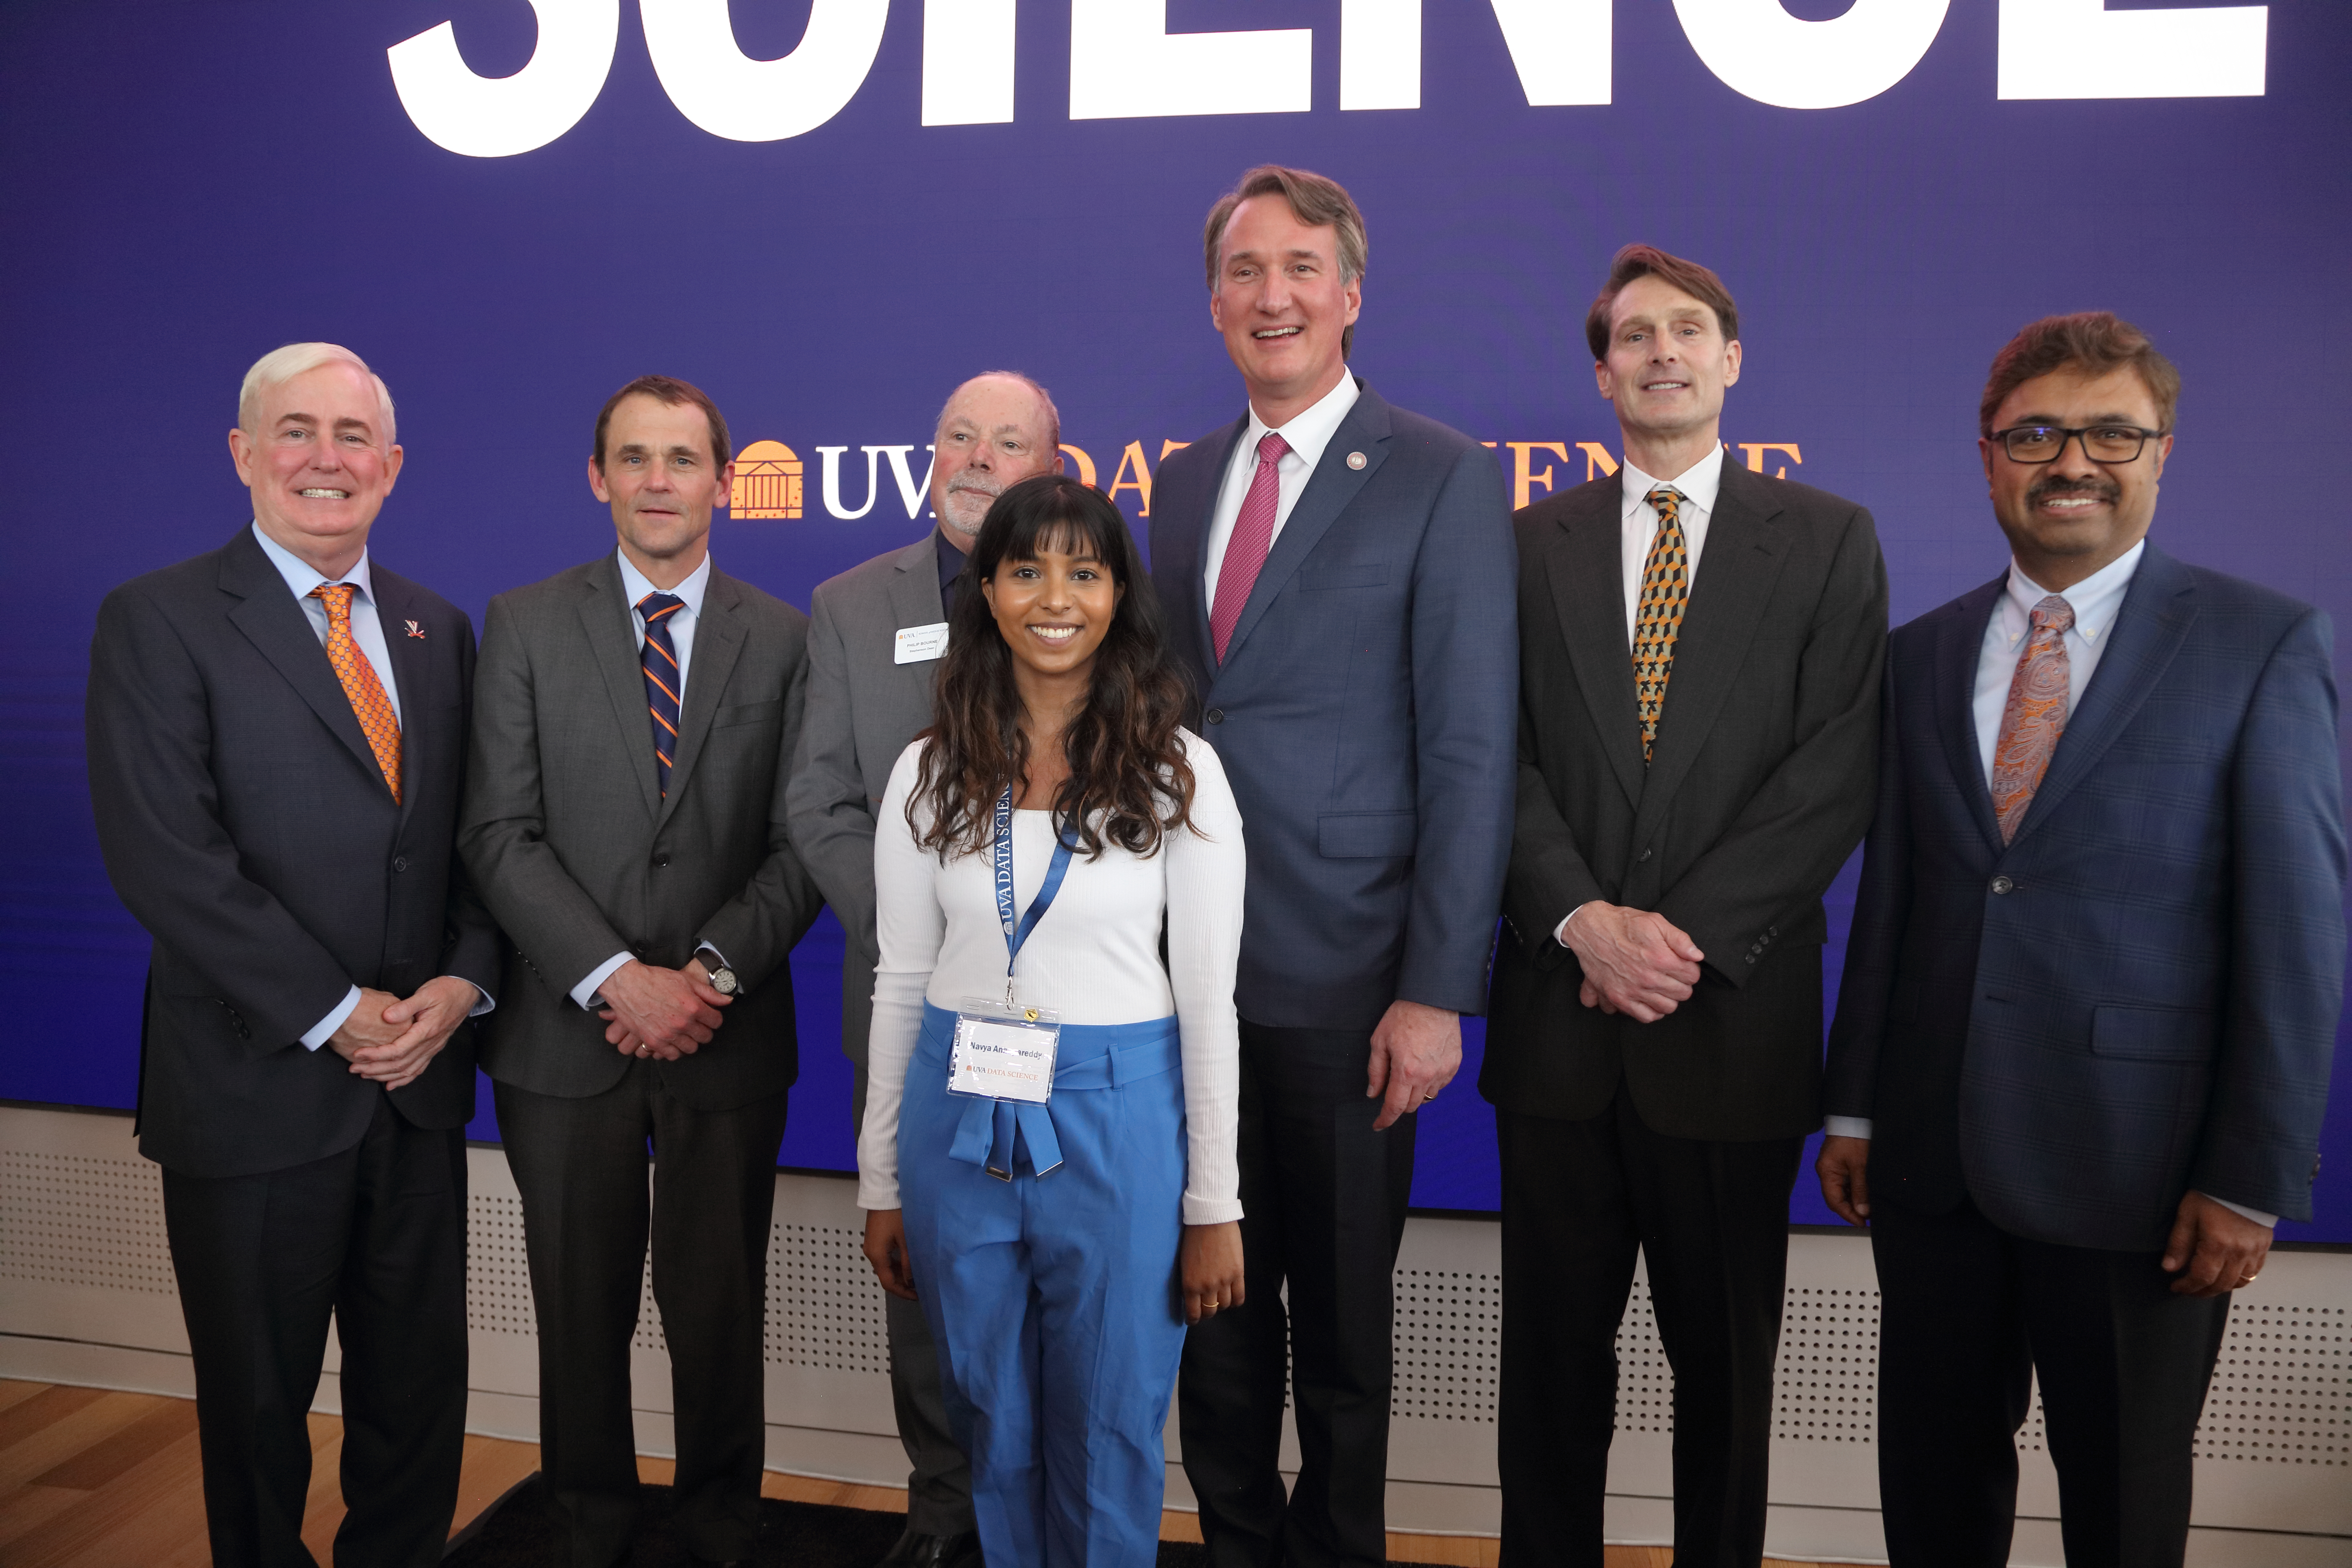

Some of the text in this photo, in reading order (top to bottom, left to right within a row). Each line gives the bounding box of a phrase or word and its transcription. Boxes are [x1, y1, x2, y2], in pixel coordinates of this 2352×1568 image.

[816, 445, 936, 519] UV
[996, 839, 1010, 884] DATA
[999, 886, 1012, 920] UVA
[971, 1042, 991, 1052] Navya
[1007, 1071, 1038, 1080] SCIENCE
